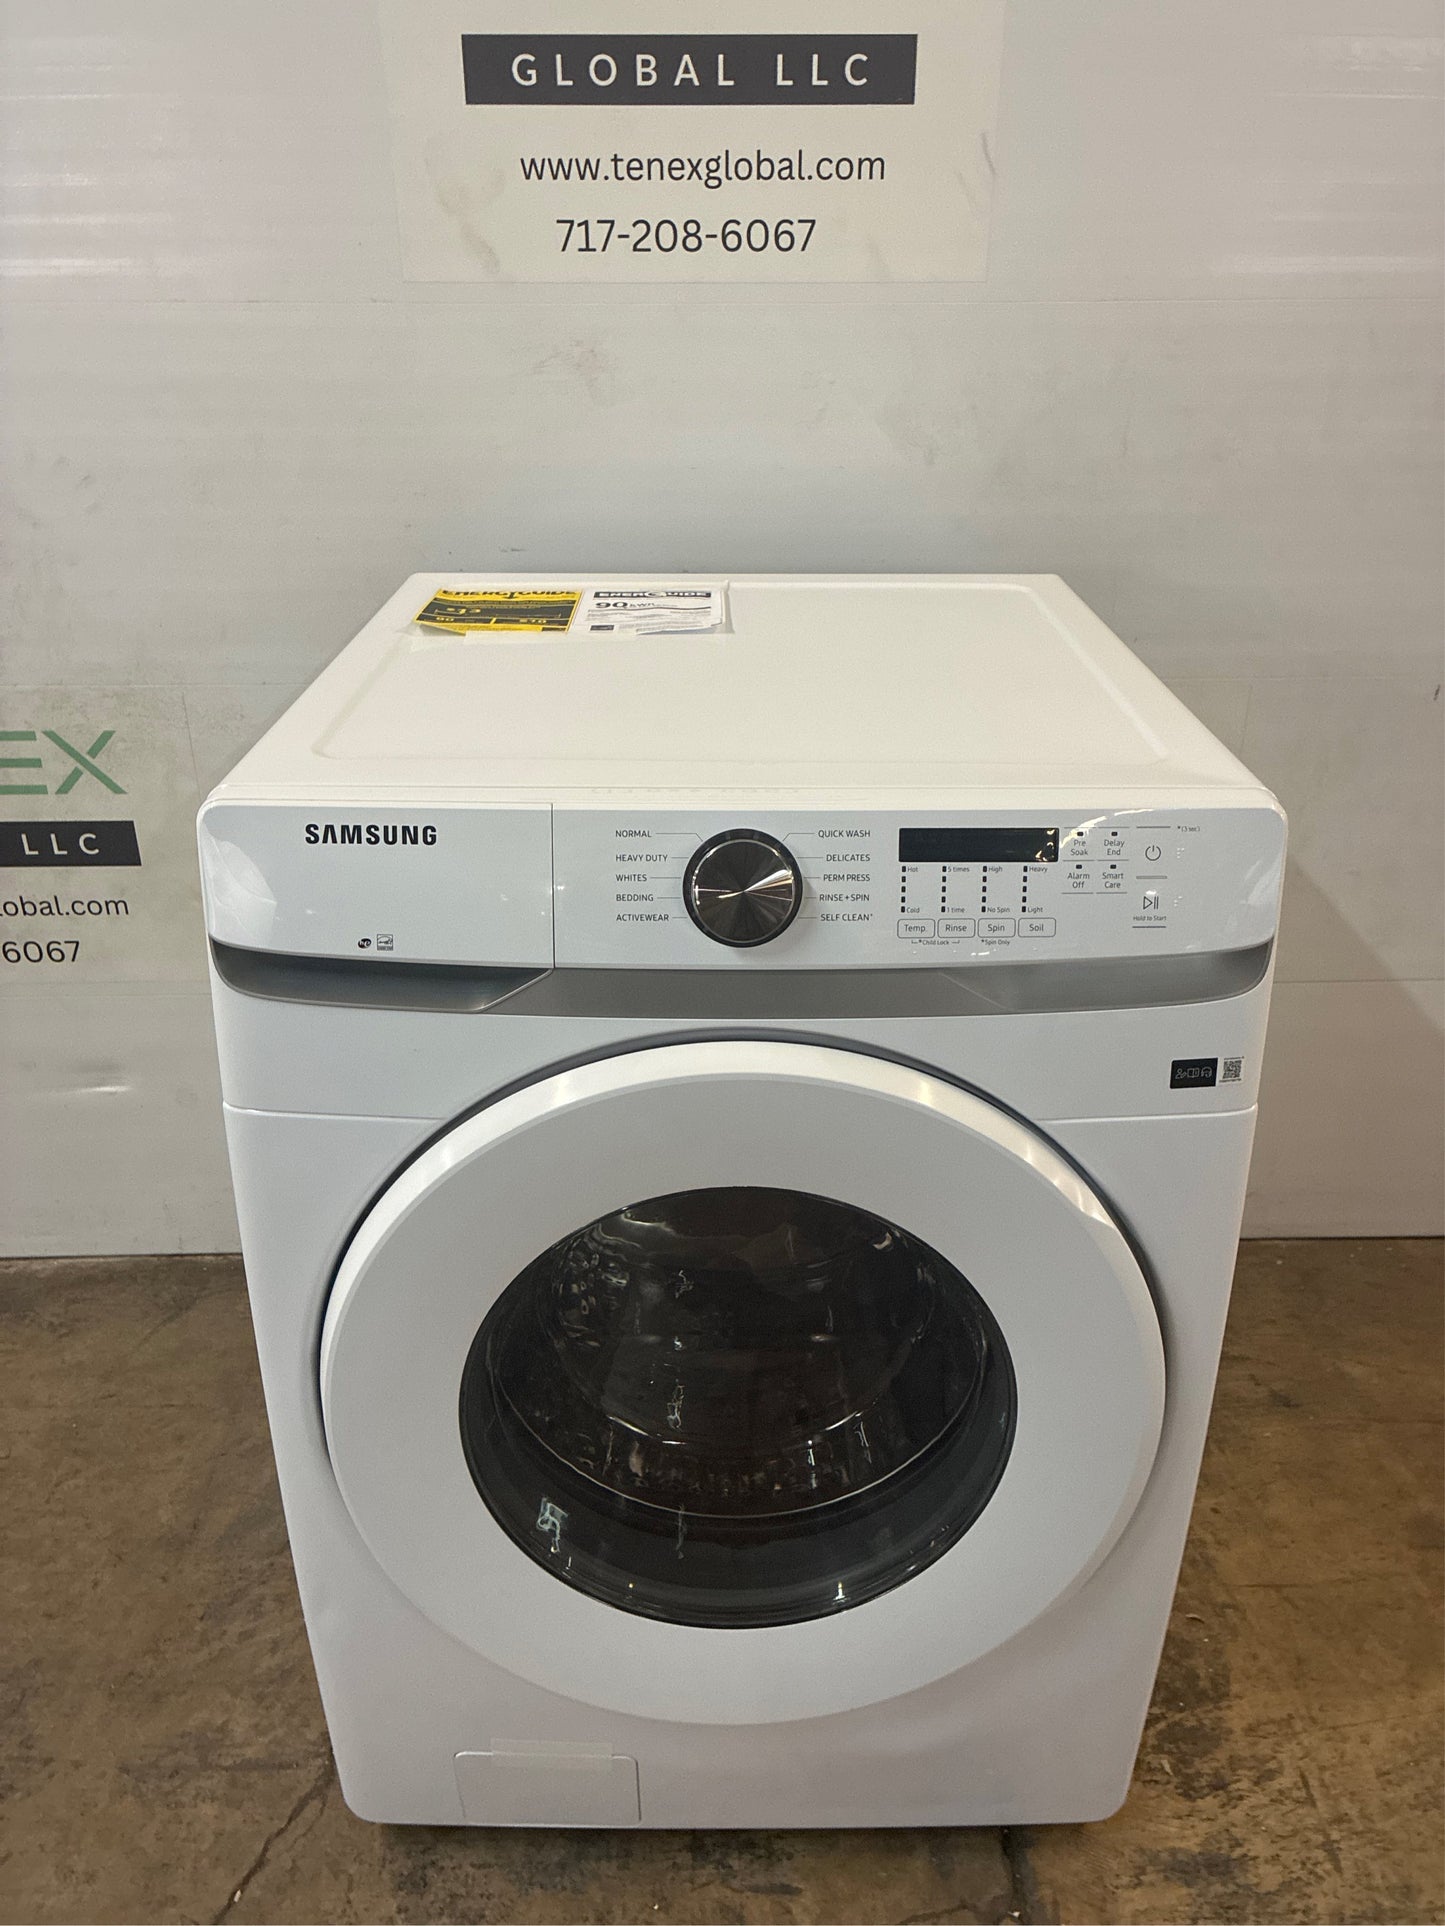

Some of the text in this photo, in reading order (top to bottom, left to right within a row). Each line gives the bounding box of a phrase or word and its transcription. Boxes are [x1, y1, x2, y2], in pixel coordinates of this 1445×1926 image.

[511, 53, 869, 87] GLOBAL LLC
[520, 149, 886, 189] www.tenexglobal.com
[556, 218, 817, 253] 717-208-6067
[305, 823, 438, 846] SAMSUNG
[615, 830, 652, 838] NORMAL
[818, 830, 844, 838] QUICK
[21, 833, 100, 856] LLC
[615, 854, 668, 862] HEAVY DUTY
[826, 854, 871, 862] DELICATES
[615, 874, 647, 882] WHITES
[823, 874, 871, 882] PERM PRESS
[616, 894, 654, 902] BEDDING
[0, 895, 129, 916] obal.com
[616, 914, 669, 922] ACTIVEWEAR
[904, 924, 926, 933] Temp
[945, 924, 967, 932] Rinse
[988, 924, 1005, 933] Spin
[1029, 924, 1044, 932] Soil
[2, 940, 80, 964] 6067
